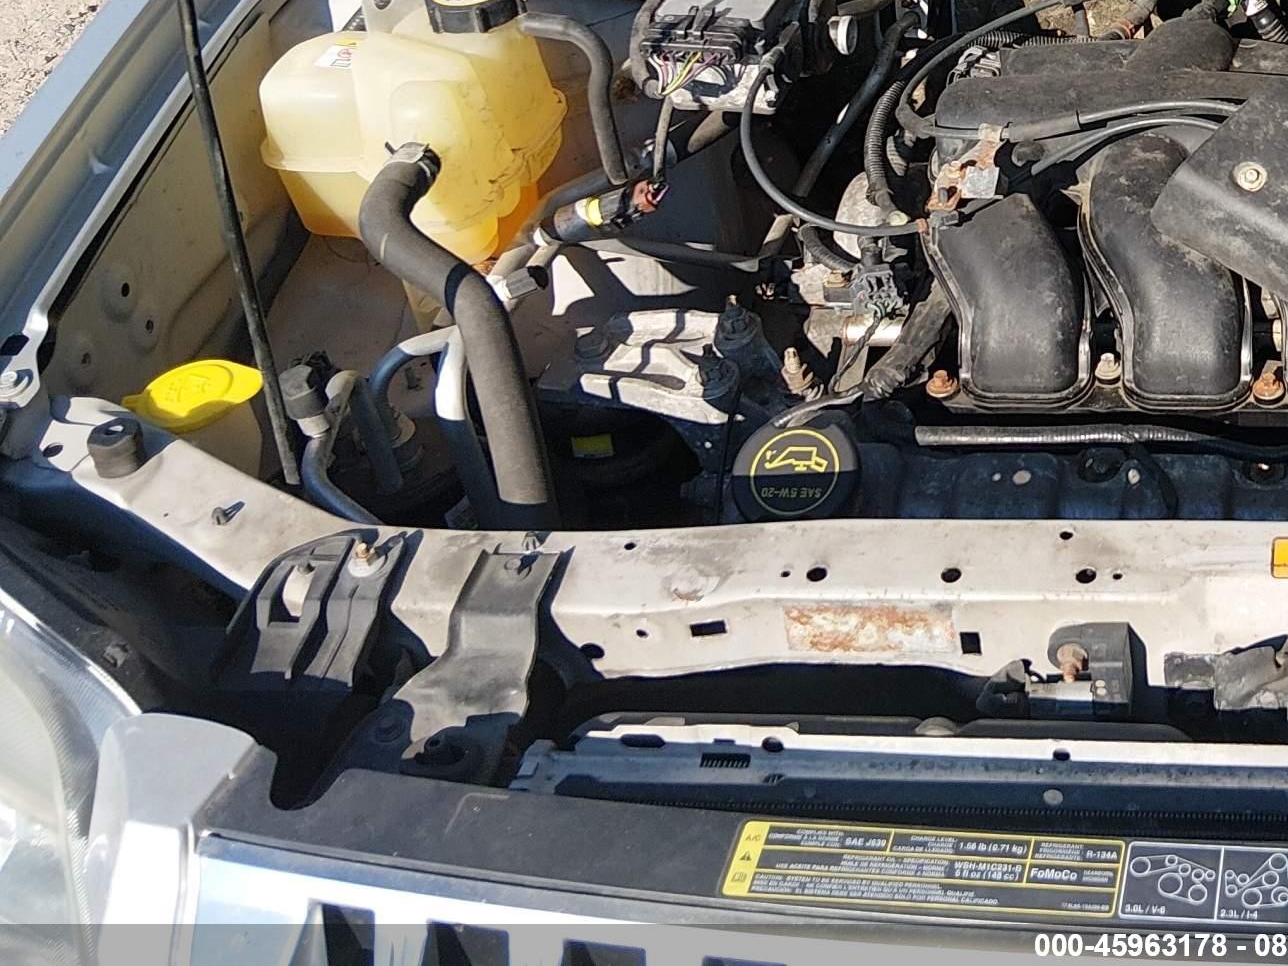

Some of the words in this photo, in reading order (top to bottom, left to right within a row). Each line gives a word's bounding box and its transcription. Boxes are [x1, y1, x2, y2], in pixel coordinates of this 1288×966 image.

[760, 486, 798, 498] 5W-20
[799, 486, 823, 499] SAE
[844, 837, 864, 845] SAE
[988, 843, 1009, 853] (0.71
[1011, 844, 1027, 855] kg)
[1085, 849, 1118, 859] R-134A
[1029, 867, 1078, 881] FoMoCo
